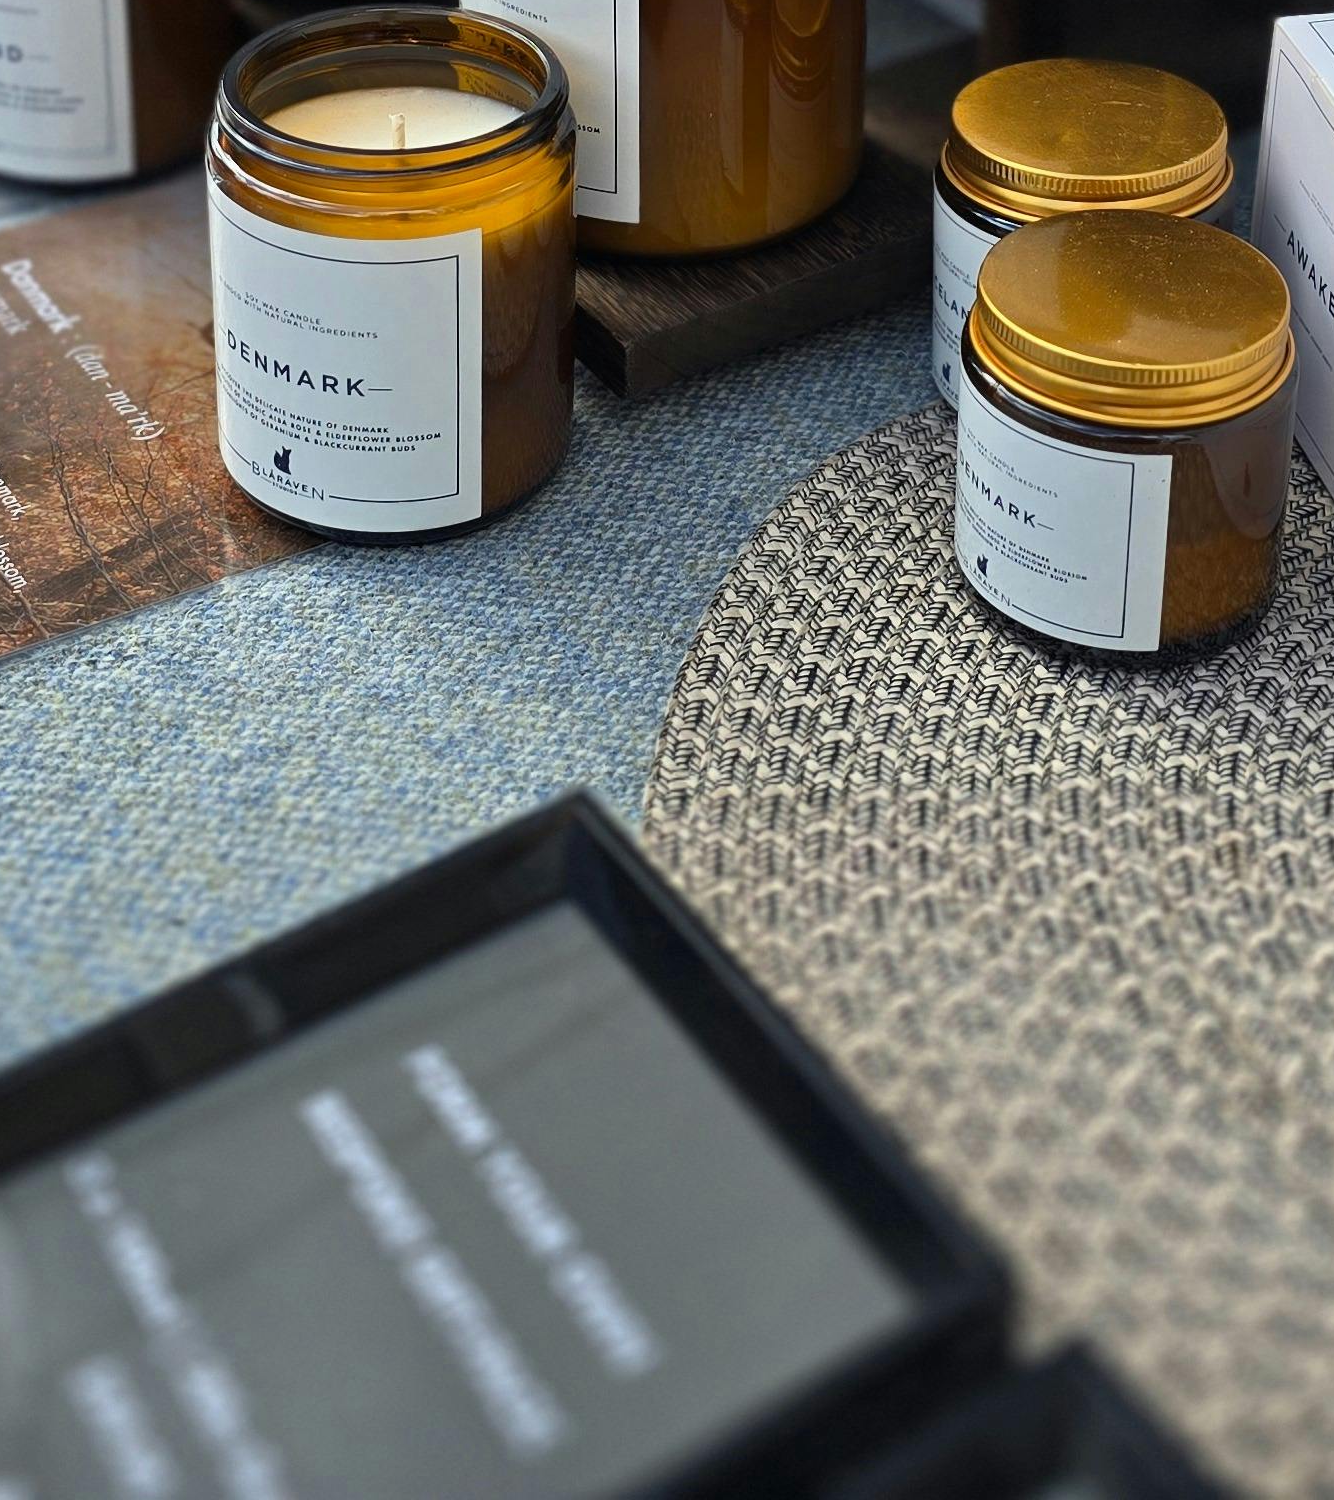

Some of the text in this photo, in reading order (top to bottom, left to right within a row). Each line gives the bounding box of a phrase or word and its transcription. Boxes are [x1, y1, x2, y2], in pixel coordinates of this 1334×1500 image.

[497, 0, 548, 23] INGREDIENTS
[244, 299, 261, 312] WITH
[264, 309, 304, 329] NATURAL
[308, 324, 378, 339] INGREDIENTS
[245, 292, 320, 325] SOY WAX CANDLE
[227, 328, 365, 397] DENMARK
[254, 396, 287, 416] DELICATE
[290, 413, 322, 427] NATURE
[342, 424, 389, 433] DENMARK
[269, 414, 287, 426] ALBA
[290, 422, 311, 434] ROSE
[326, 431, 391, 443] ELDERFLOWER
[396, 432, 441, 443] BLOSSOM
[260, 418, 301, 440] GERANIUM
[314, 438, 387, 452] BLACKCURRANT
[959, 449, 1036, 528] DENMARK
[1006, 471, 1058, 498] INGREDIENTS
